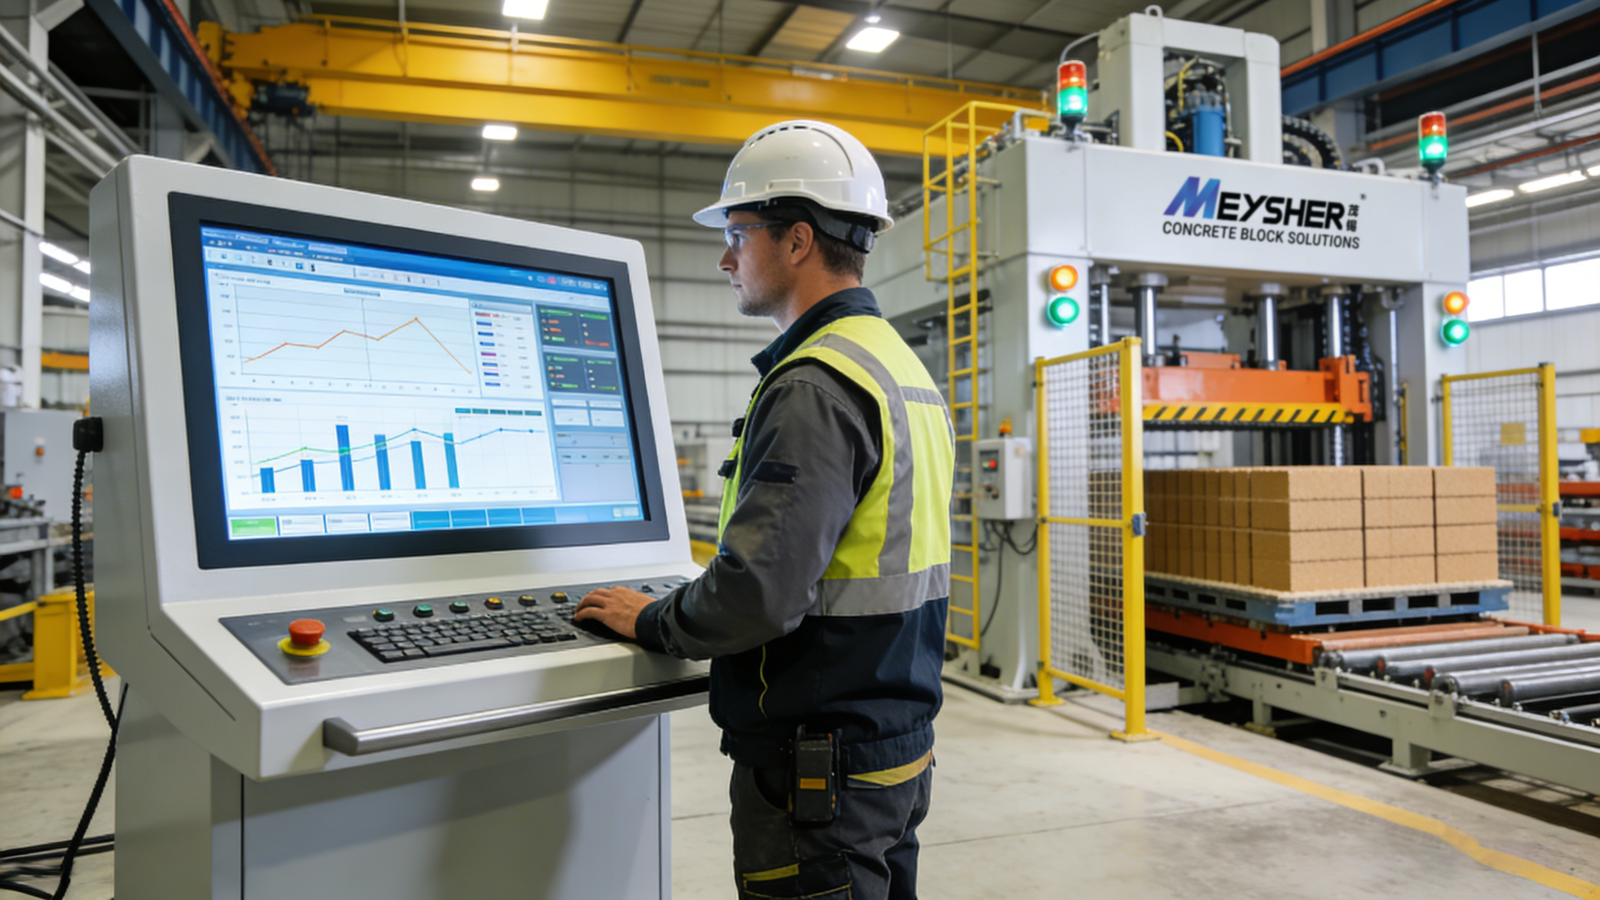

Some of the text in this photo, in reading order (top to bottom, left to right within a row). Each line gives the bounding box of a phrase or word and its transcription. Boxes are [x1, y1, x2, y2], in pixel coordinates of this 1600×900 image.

[1163, 176, 1345, 231] MEYSHER
[1162, 220, 1360, 249] CONCRETE BLOCK SOLUTIONS
